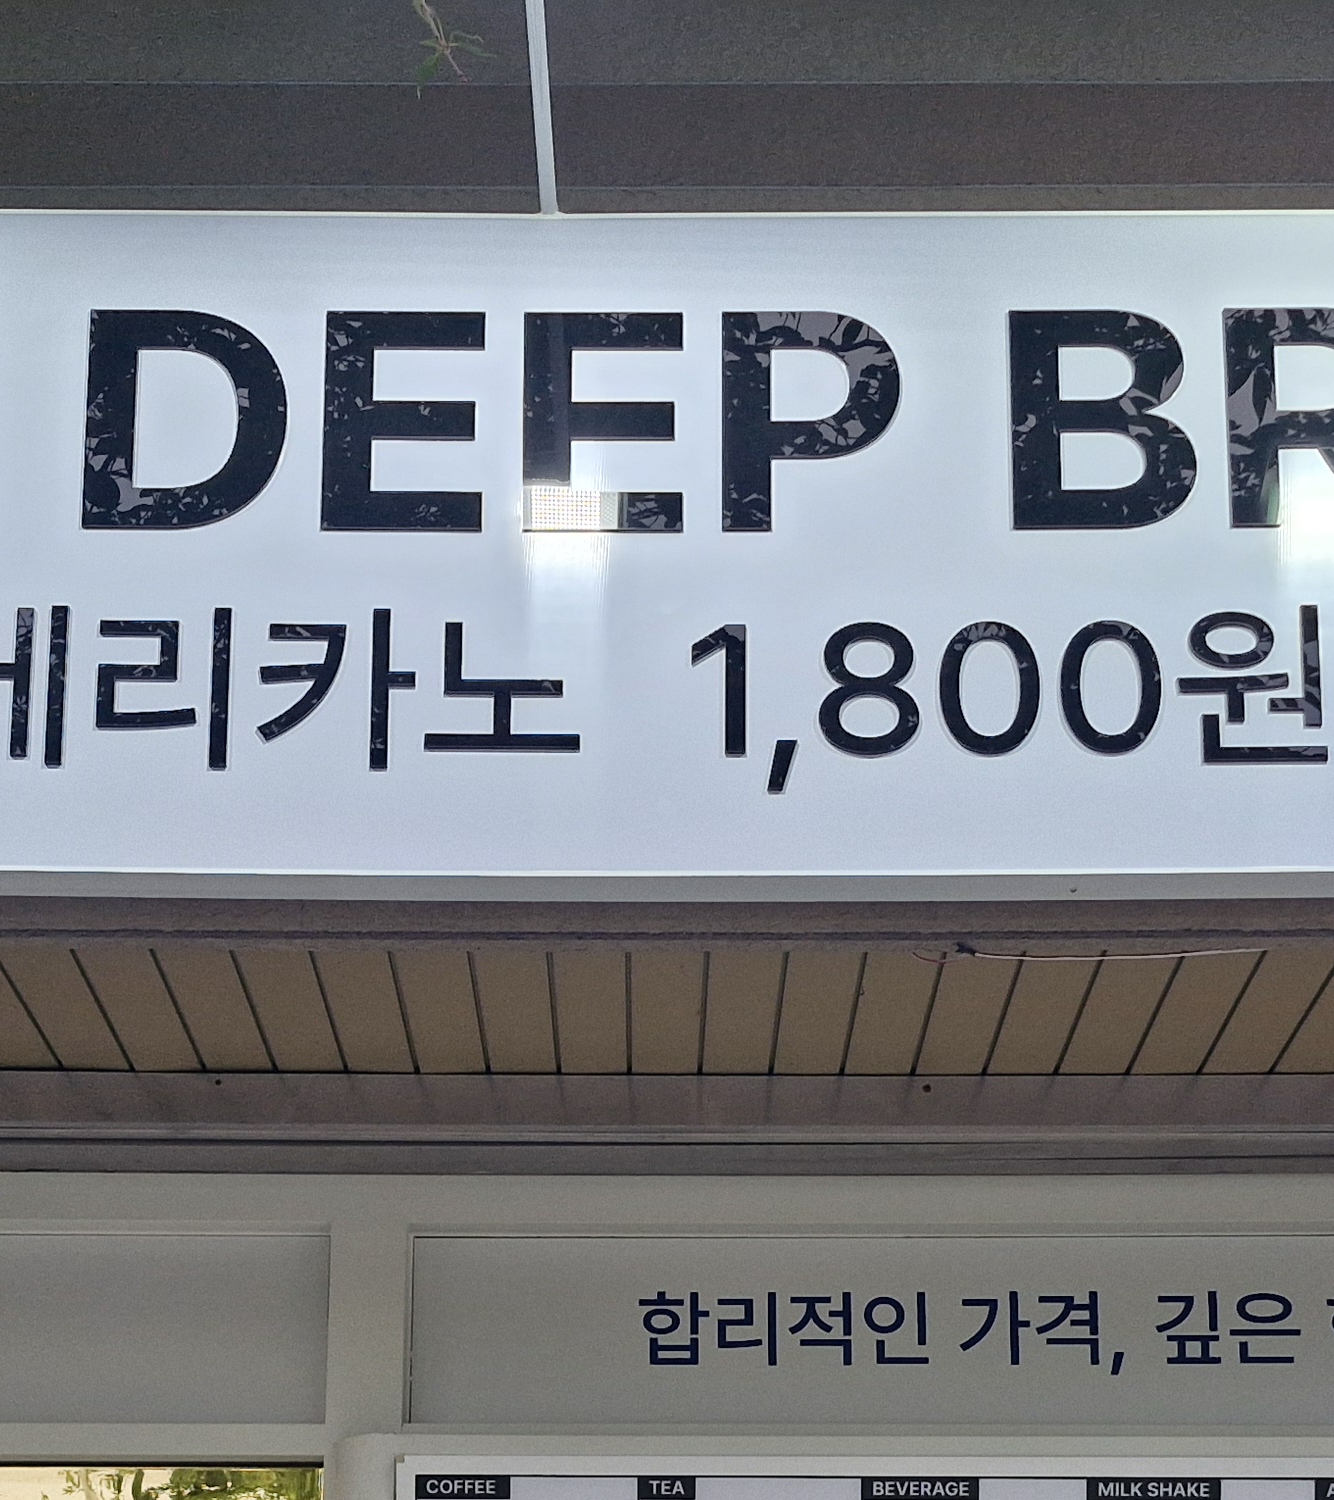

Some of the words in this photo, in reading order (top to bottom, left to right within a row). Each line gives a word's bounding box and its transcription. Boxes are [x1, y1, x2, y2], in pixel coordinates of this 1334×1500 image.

[81, 309, 902, 533] DEEP
[691, 605, 1329, 794] 1,800원
[637, 1291, 929, 1366] 합리적인
[959, 1290, 1125, 1375] 가격,
[1155, 1291, 1303, 1366] 깊은
[426, 1480, 495, 1494] COFFEE
[649, 1480, 685, 1494] TEA
[873, 1482, 969, 1496] BEVERAGE
[1098, 1482, 1142, 1497] MILK
[1147, 1483, 1210, 1497] SHAKE
